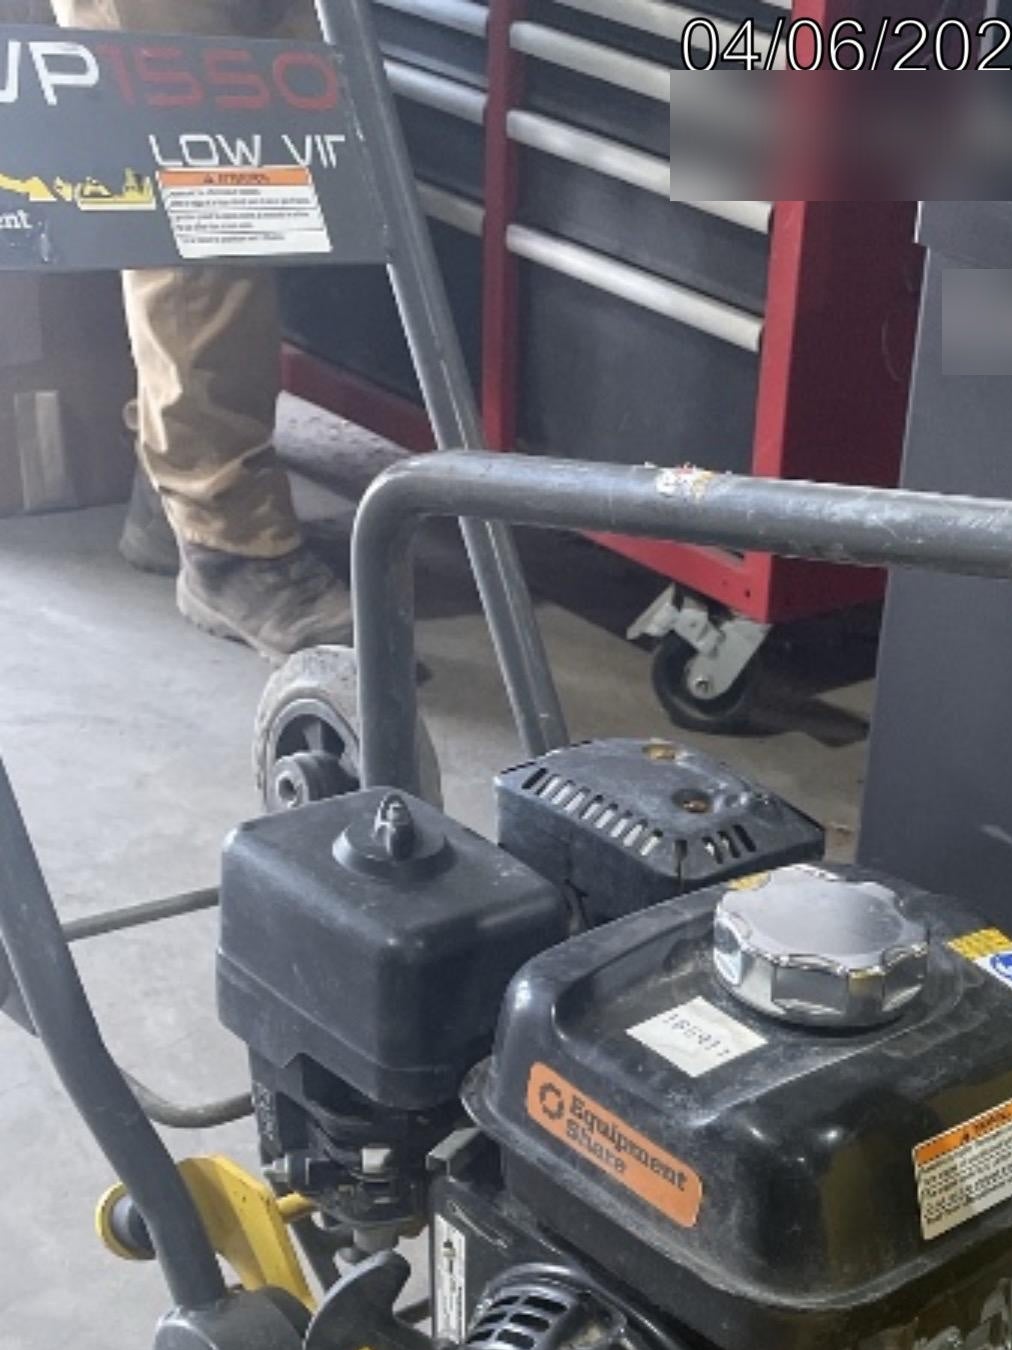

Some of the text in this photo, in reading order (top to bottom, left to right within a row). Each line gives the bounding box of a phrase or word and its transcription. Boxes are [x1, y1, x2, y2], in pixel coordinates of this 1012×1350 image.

[0, 40, 340, 111] P1550
[148, 134, 262, 167] LOW
[565, 1118, 627, 1173] Share
[569, 1094, 687, 1192] Equipment
